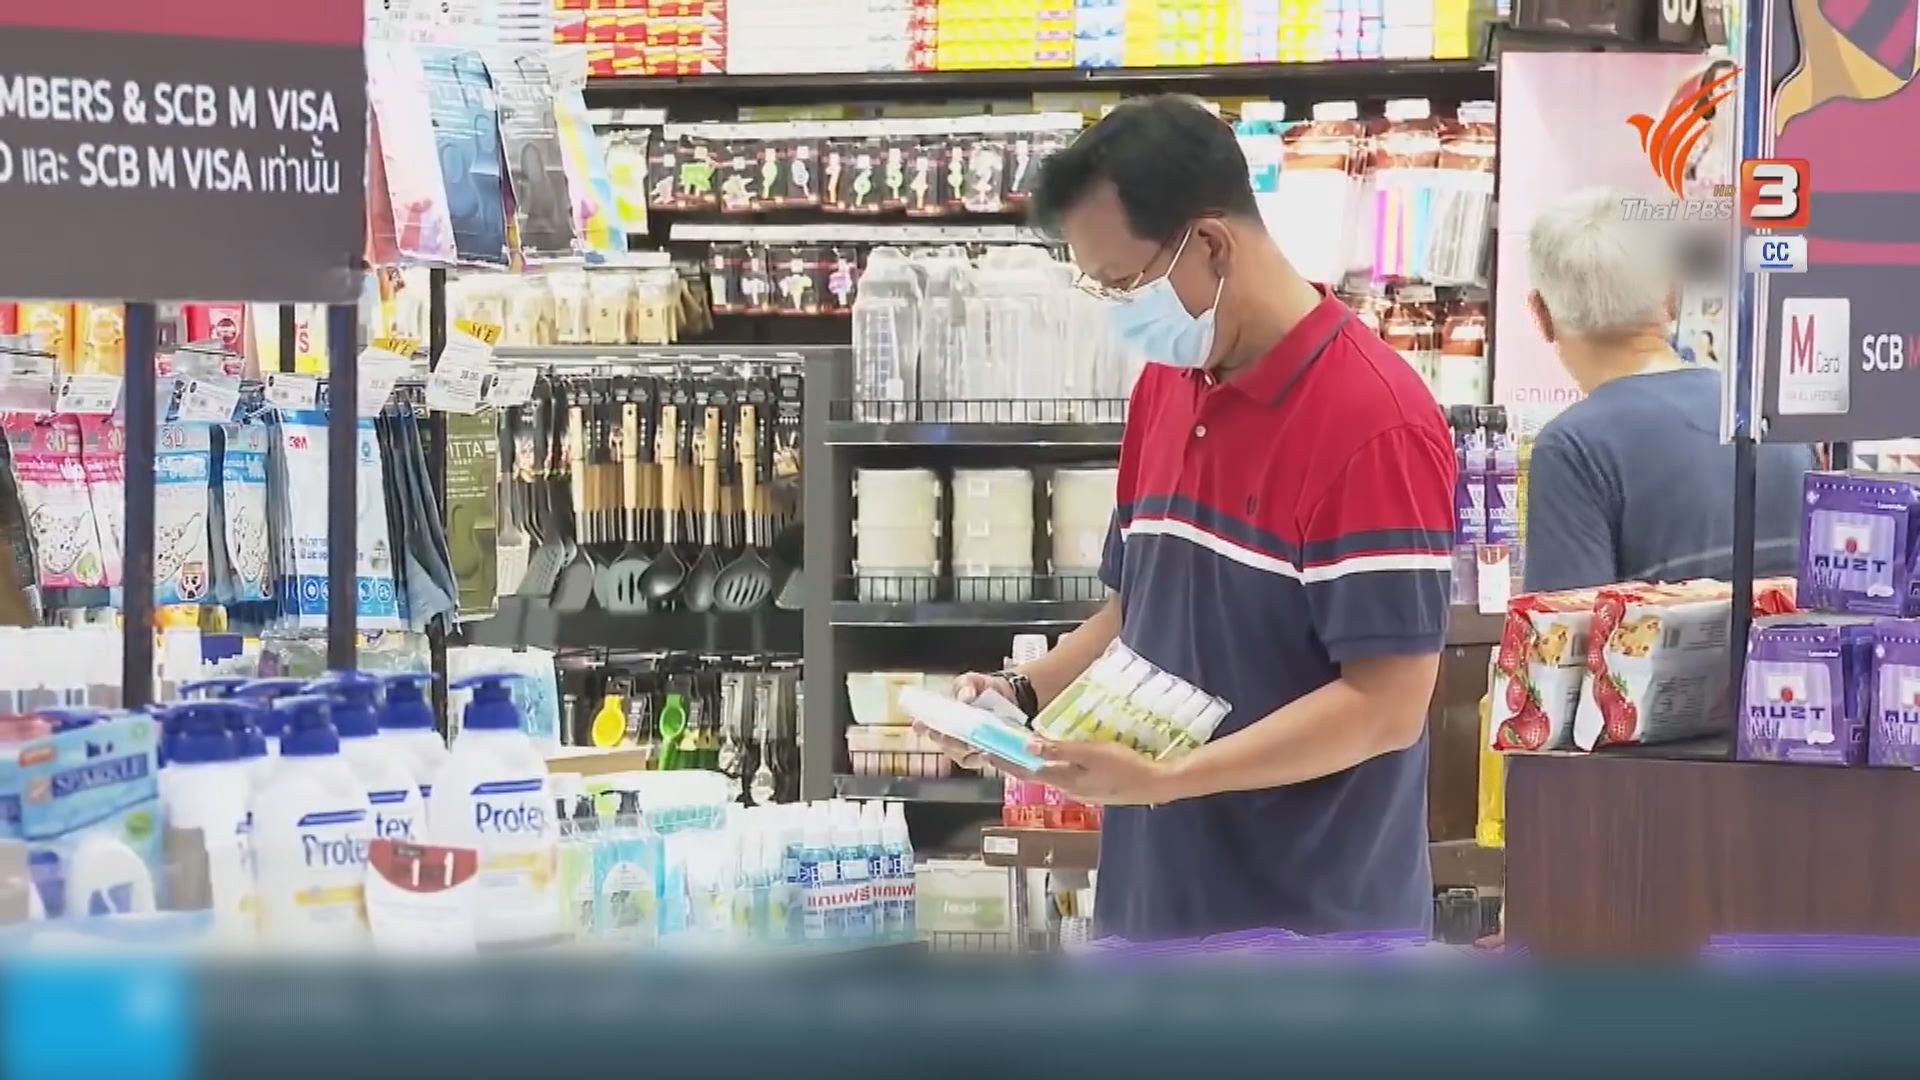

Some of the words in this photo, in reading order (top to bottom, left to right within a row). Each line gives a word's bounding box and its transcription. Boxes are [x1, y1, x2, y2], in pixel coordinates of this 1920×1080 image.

[0, 74, 114, 123] MBERS
[123, 79, 147, 125] &
[154, 82, 217, 126] SCB
[228, 85, 256, 129] M
[267, 87, 340, 133] VISA
[22, 147, 70, 186] และ
[77, 142, 141, 188] SCB
[148, 145, 176, 189] M
[181, 147, 253, 192] VISA
[259, 134, 340, 194] เท่านั้น
[1790, 314, 1815, 375] M
[1862, 334, 1904, 372] SCB
[448, 439, 484, 459] ITTA
[302, 832, 368, 868] Prote
